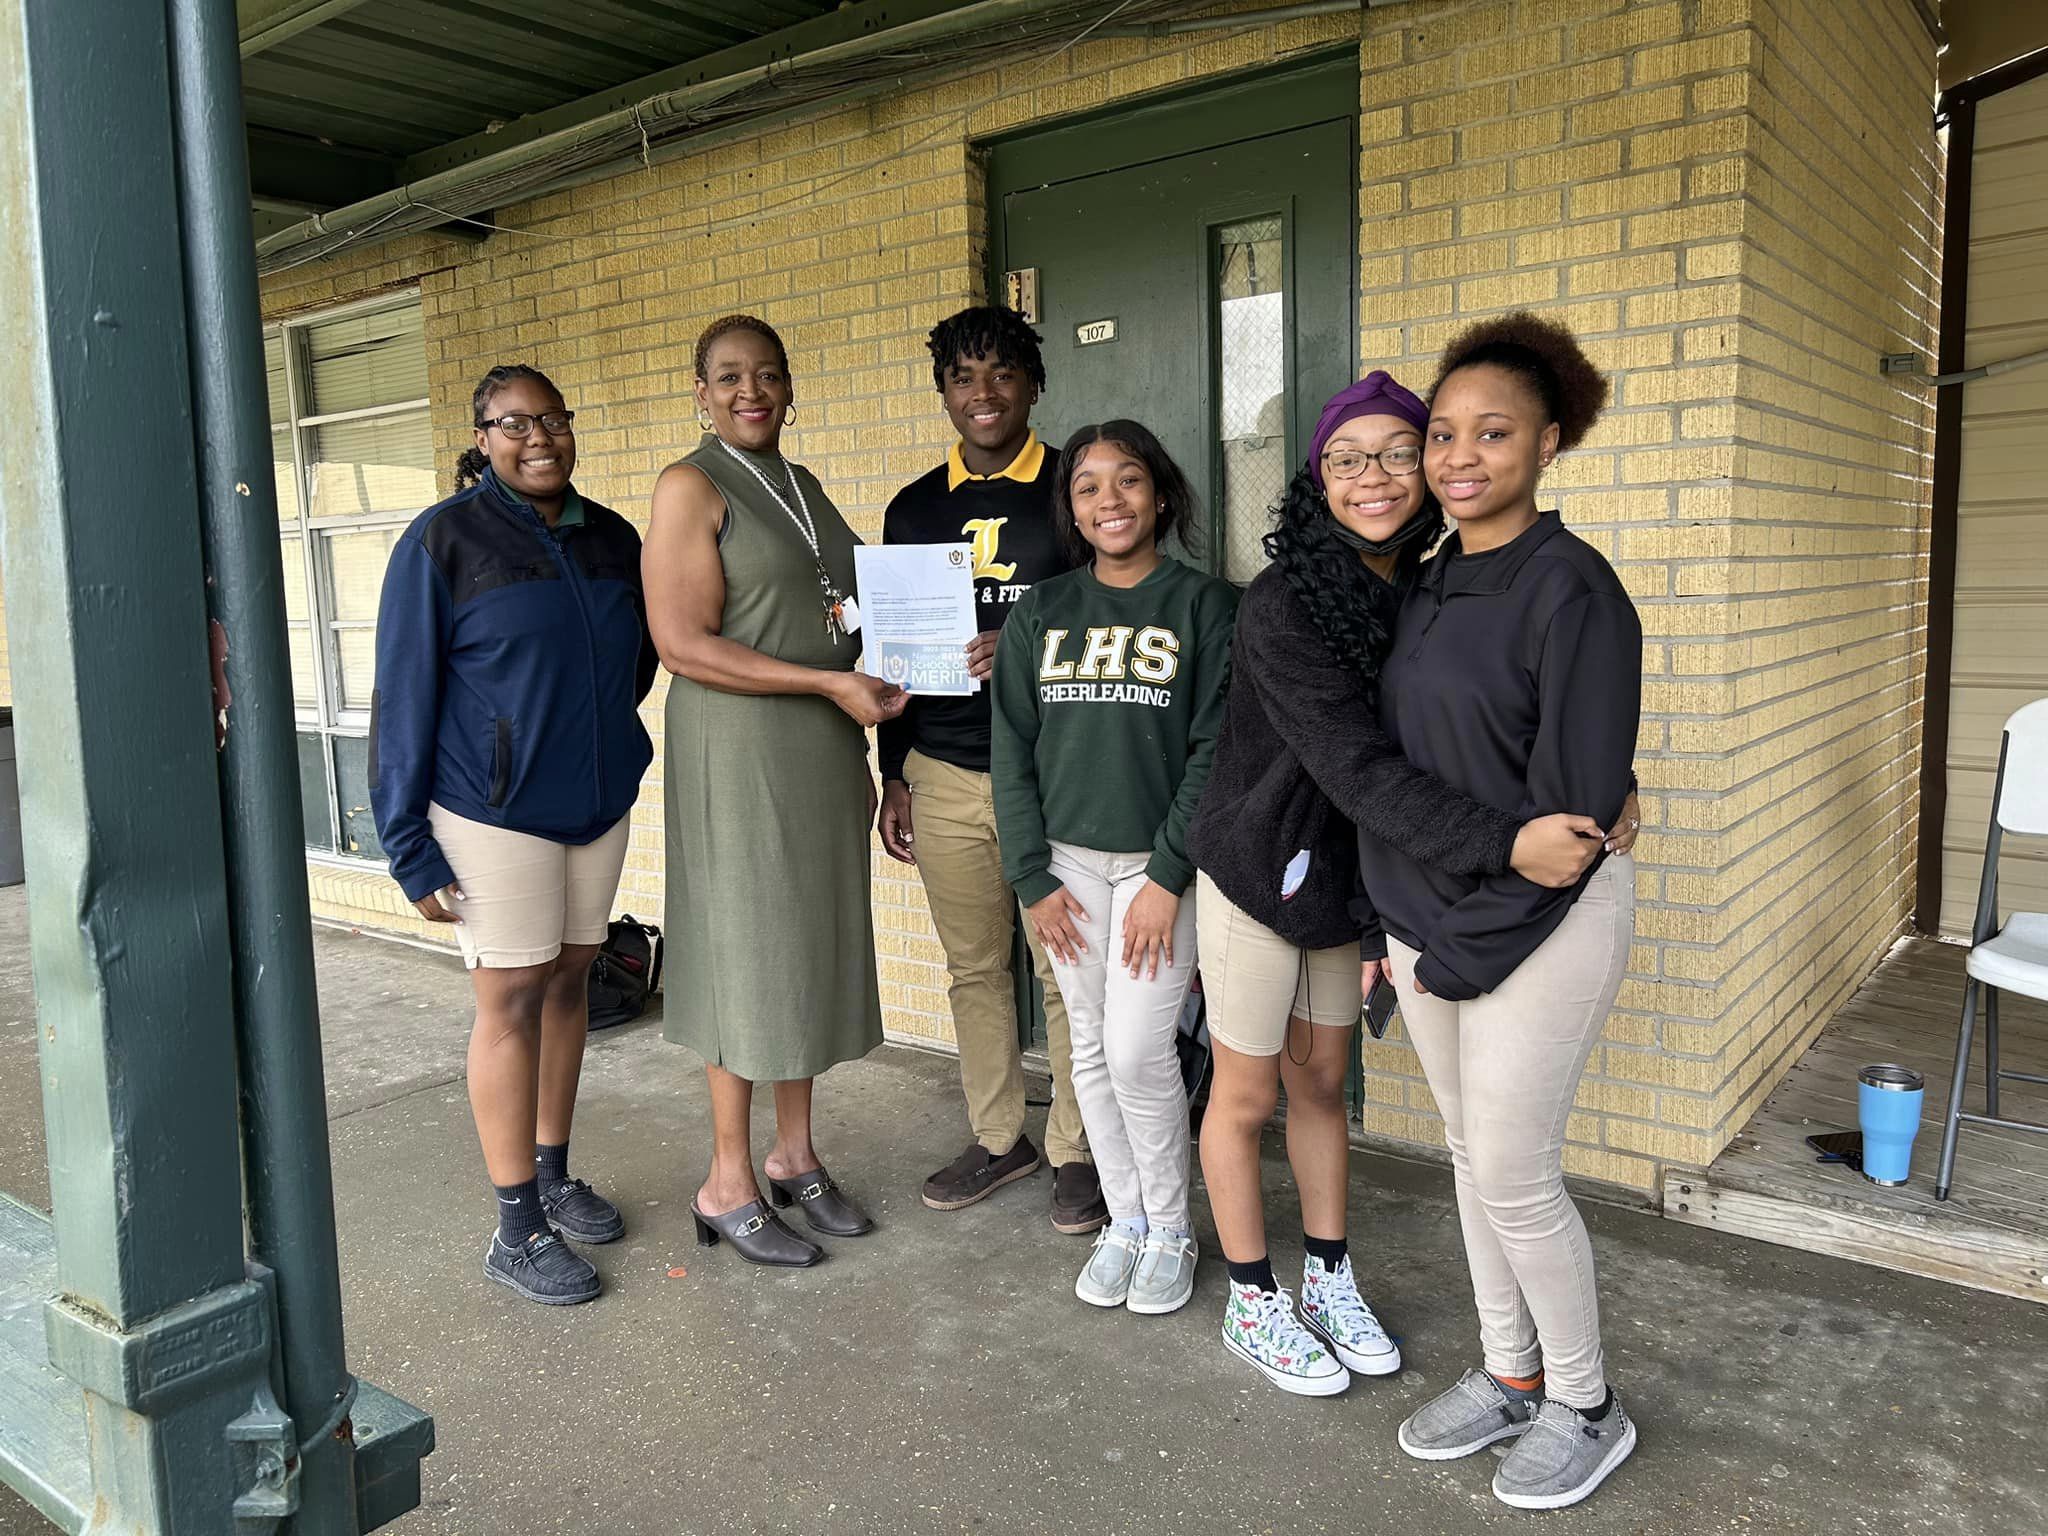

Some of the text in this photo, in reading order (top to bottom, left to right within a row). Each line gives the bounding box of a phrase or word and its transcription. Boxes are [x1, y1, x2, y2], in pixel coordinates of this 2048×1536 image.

[1087, 325, 1106, 340] 107
[961, 517, 1018, 582] L
[1039, 625, 1180, 685] LHS
[911, 669, 967, 684] MERIT
[1040, 683, 1172, 707] CHEERLEADING
